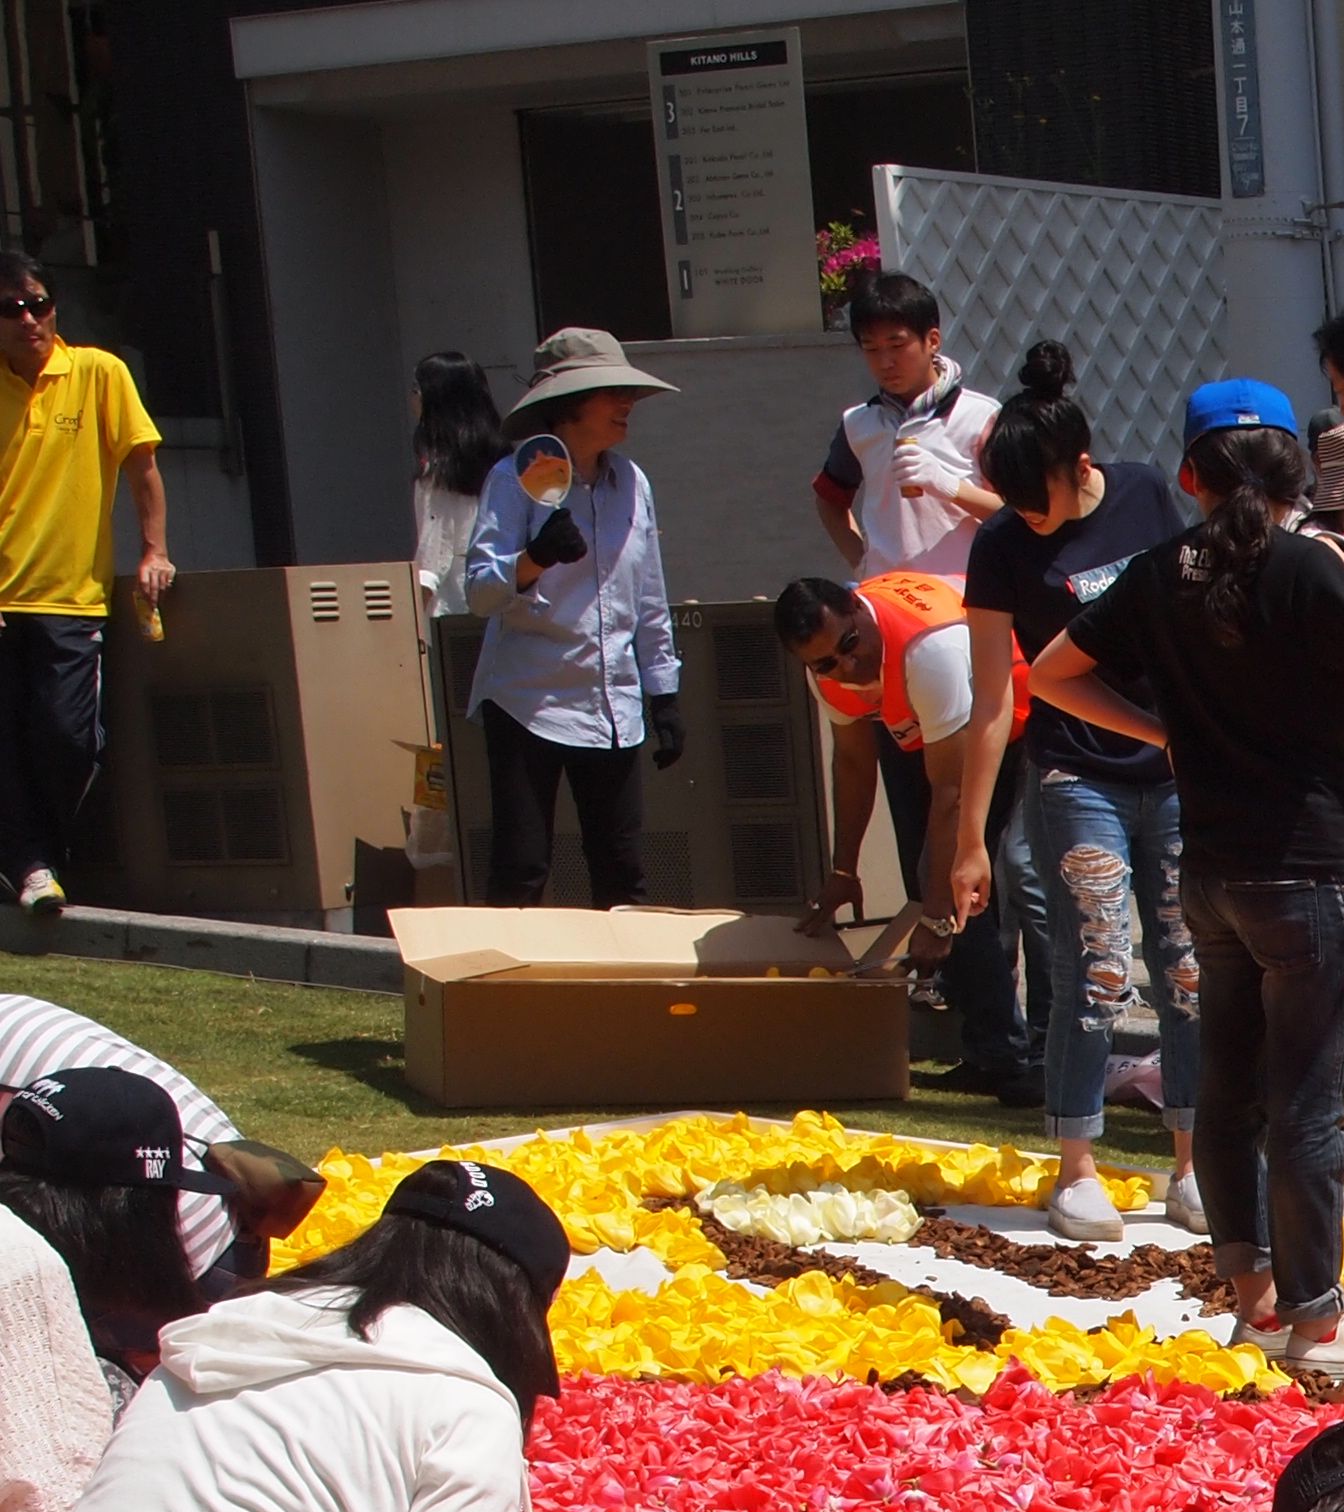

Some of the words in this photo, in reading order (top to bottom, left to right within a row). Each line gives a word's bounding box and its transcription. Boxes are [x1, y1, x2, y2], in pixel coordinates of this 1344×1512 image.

[689, 53, 728, 66] KITANO
[729, 50, 758, 63] HILLS
[666, 102, 676, 123] 3
[673, 189, 684, 211] 2
[145, 1159, 166, 1179] RAY
